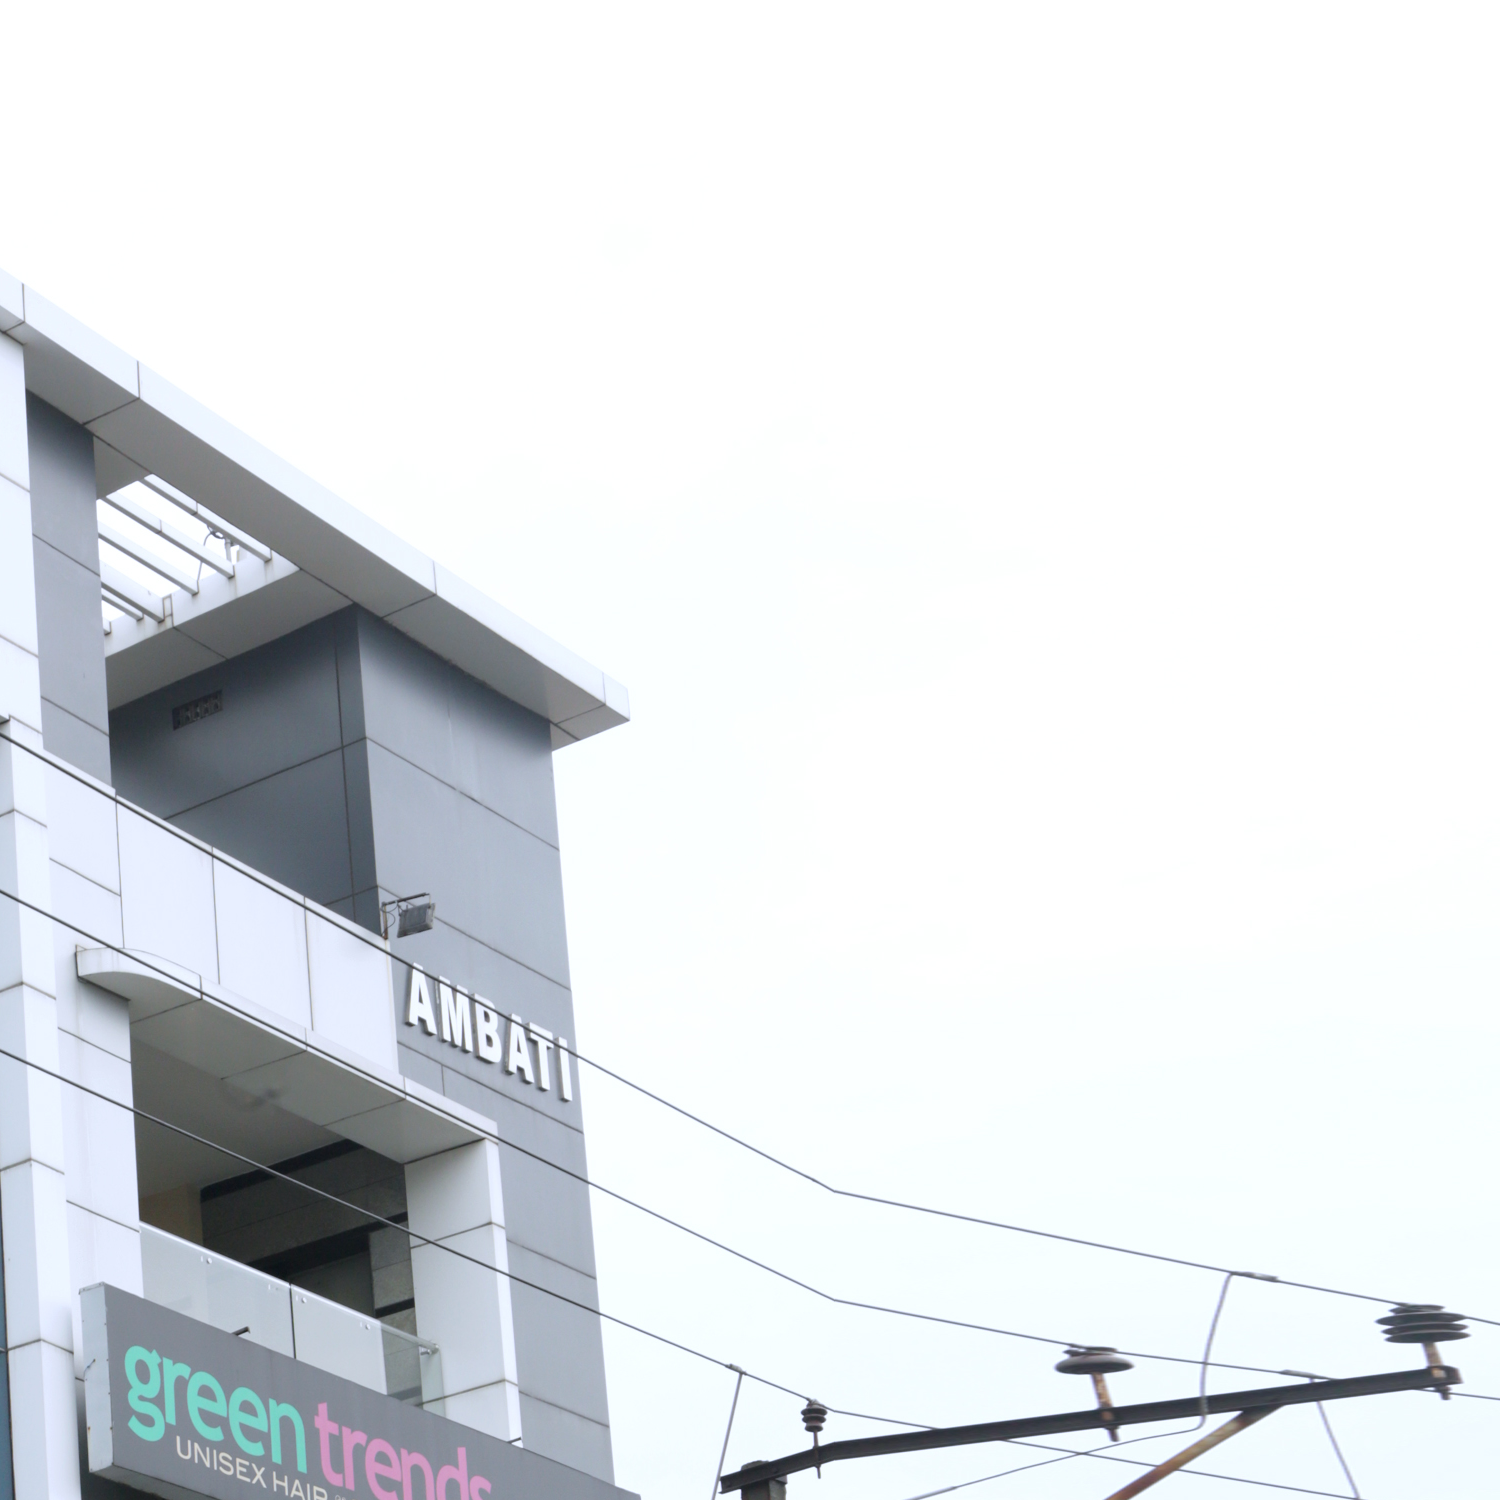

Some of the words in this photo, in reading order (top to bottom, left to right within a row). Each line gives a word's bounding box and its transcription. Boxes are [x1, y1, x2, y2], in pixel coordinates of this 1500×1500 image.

[405, 962, 573, 1103] AMBATI
[125, 1345, 307, 1474] green
[176, 1435, 267, 1489] UNISEX
